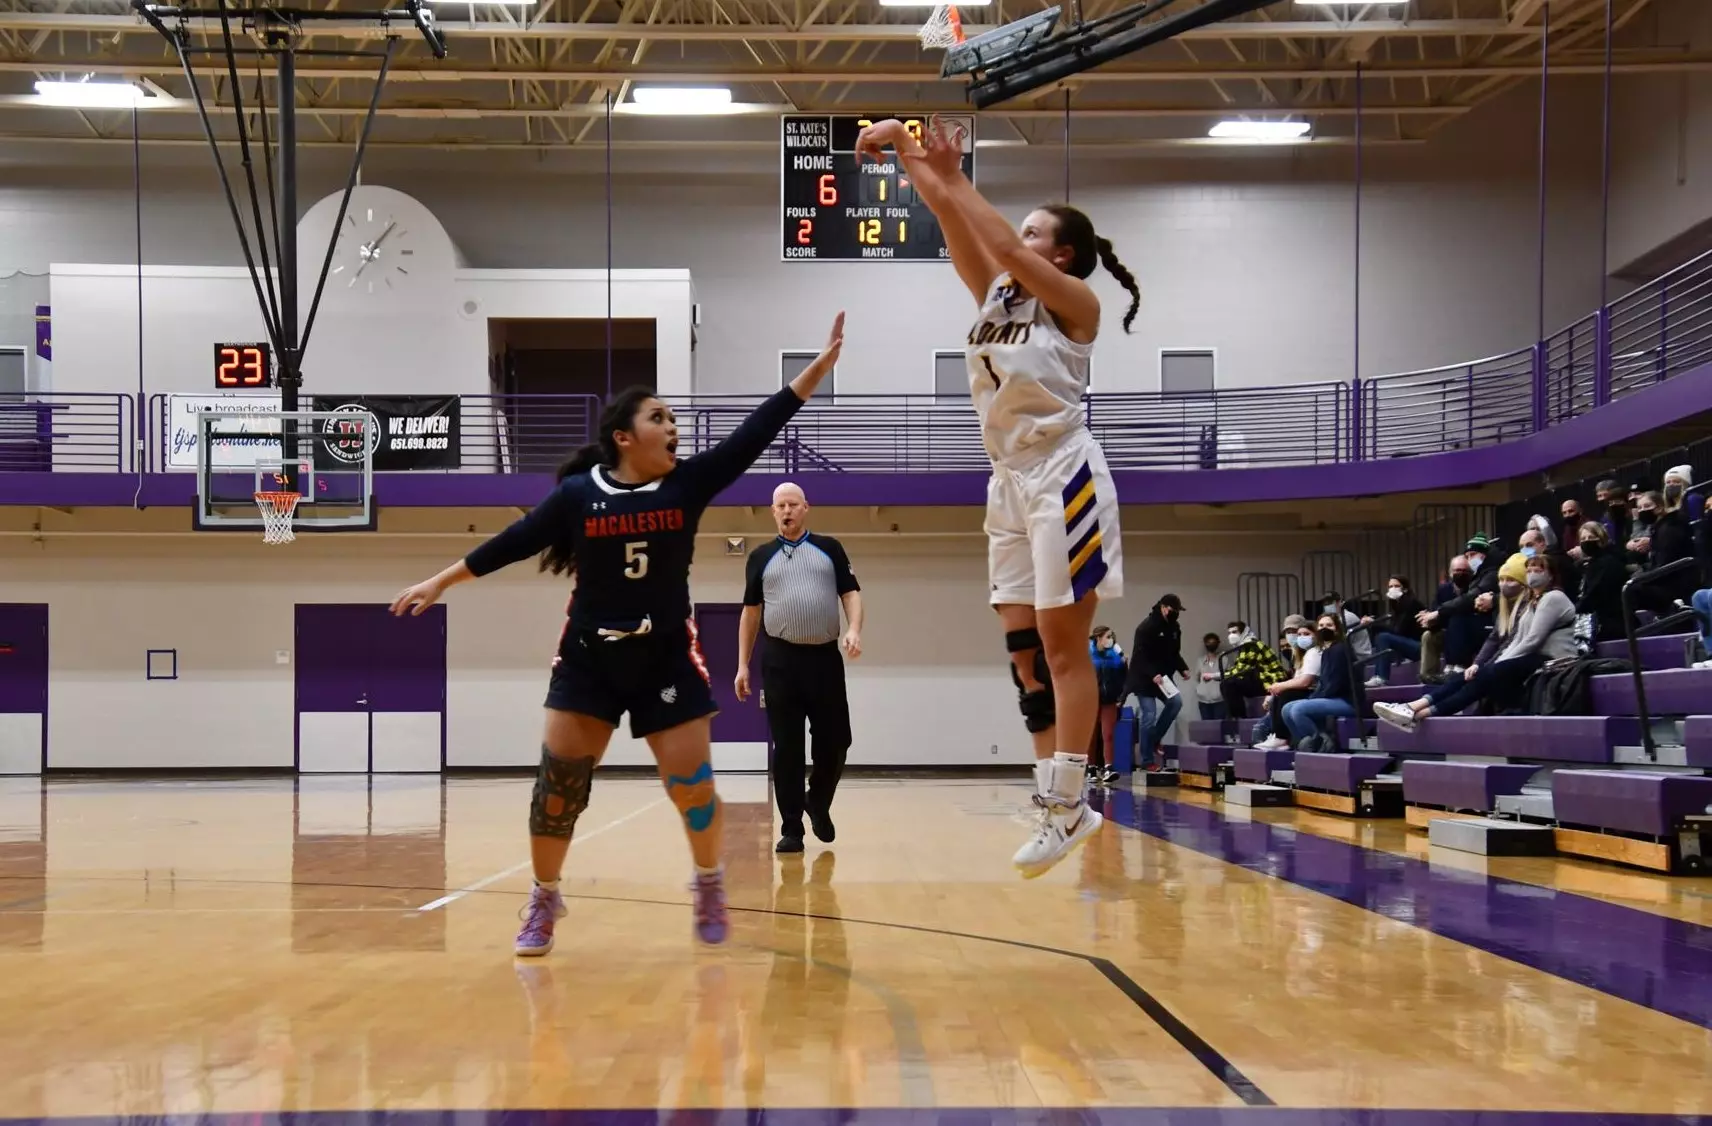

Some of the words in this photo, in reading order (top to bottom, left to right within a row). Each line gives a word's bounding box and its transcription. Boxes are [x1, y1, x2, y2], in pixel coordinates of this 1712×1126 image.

[786, 123, 798, 134] ST.
[800, 122, 828, 134] KATE'S
[786, 135, 828, 147] WILDCATS
[794, 155, 833, 170] HOME
[861, 163, 895, 174] PERIOD
[819, 174, 837, 205] 6
[879, 178, 886, 201] 1
[786, 207, 817, 218] FOULS
[846, 207, 881, 218] PLAYER
[886, 207, 910, 218] FOUL
[798, 219, 812, 244] 2
[859, 219, 882, 244] 12
[899, 220, 906, 243] 1
[786, 247, 817, 258] SCORE
[862, 247, 894, 258] MATCH
[219, 348, 262, 383] 23
[980, 355, 1001, 391] 1
[186, 402, 212, 413] Liv
[388, 416, 405, 435] WE
[405, 416, 450, 435] DELIVER!
[583, 508, 683, 538] MACALESTER
[624, 541, 648, 579] 5
